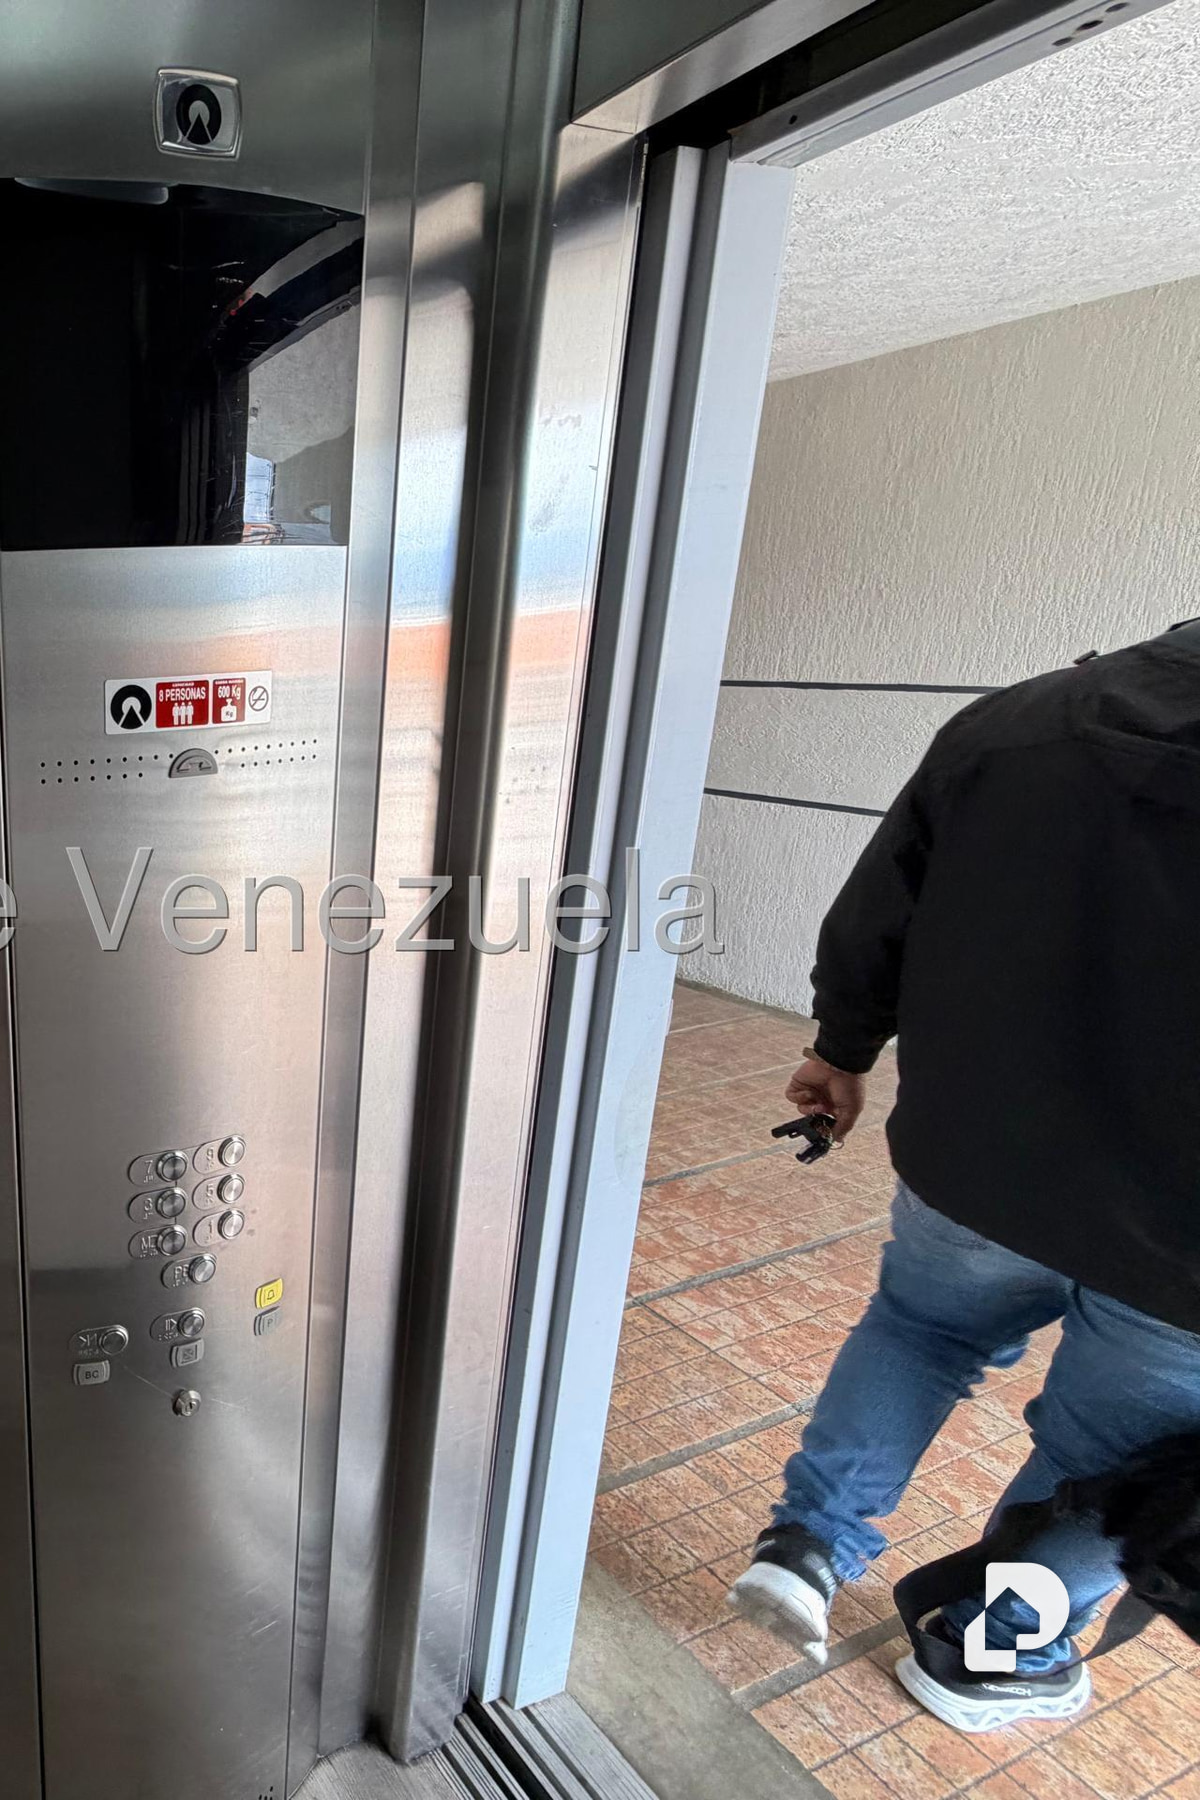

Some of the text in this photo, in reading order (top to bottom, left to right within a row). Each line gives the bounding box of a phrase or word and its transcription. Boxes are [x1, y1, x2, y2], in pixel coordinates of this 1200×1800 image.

[159, 686, 206, 702] 8 PERSONAS
[217, 684, 241, 700] 600 Kg
[145, 1159, 153, 1174] 7
[85, 1369, 99, 1379] BC
